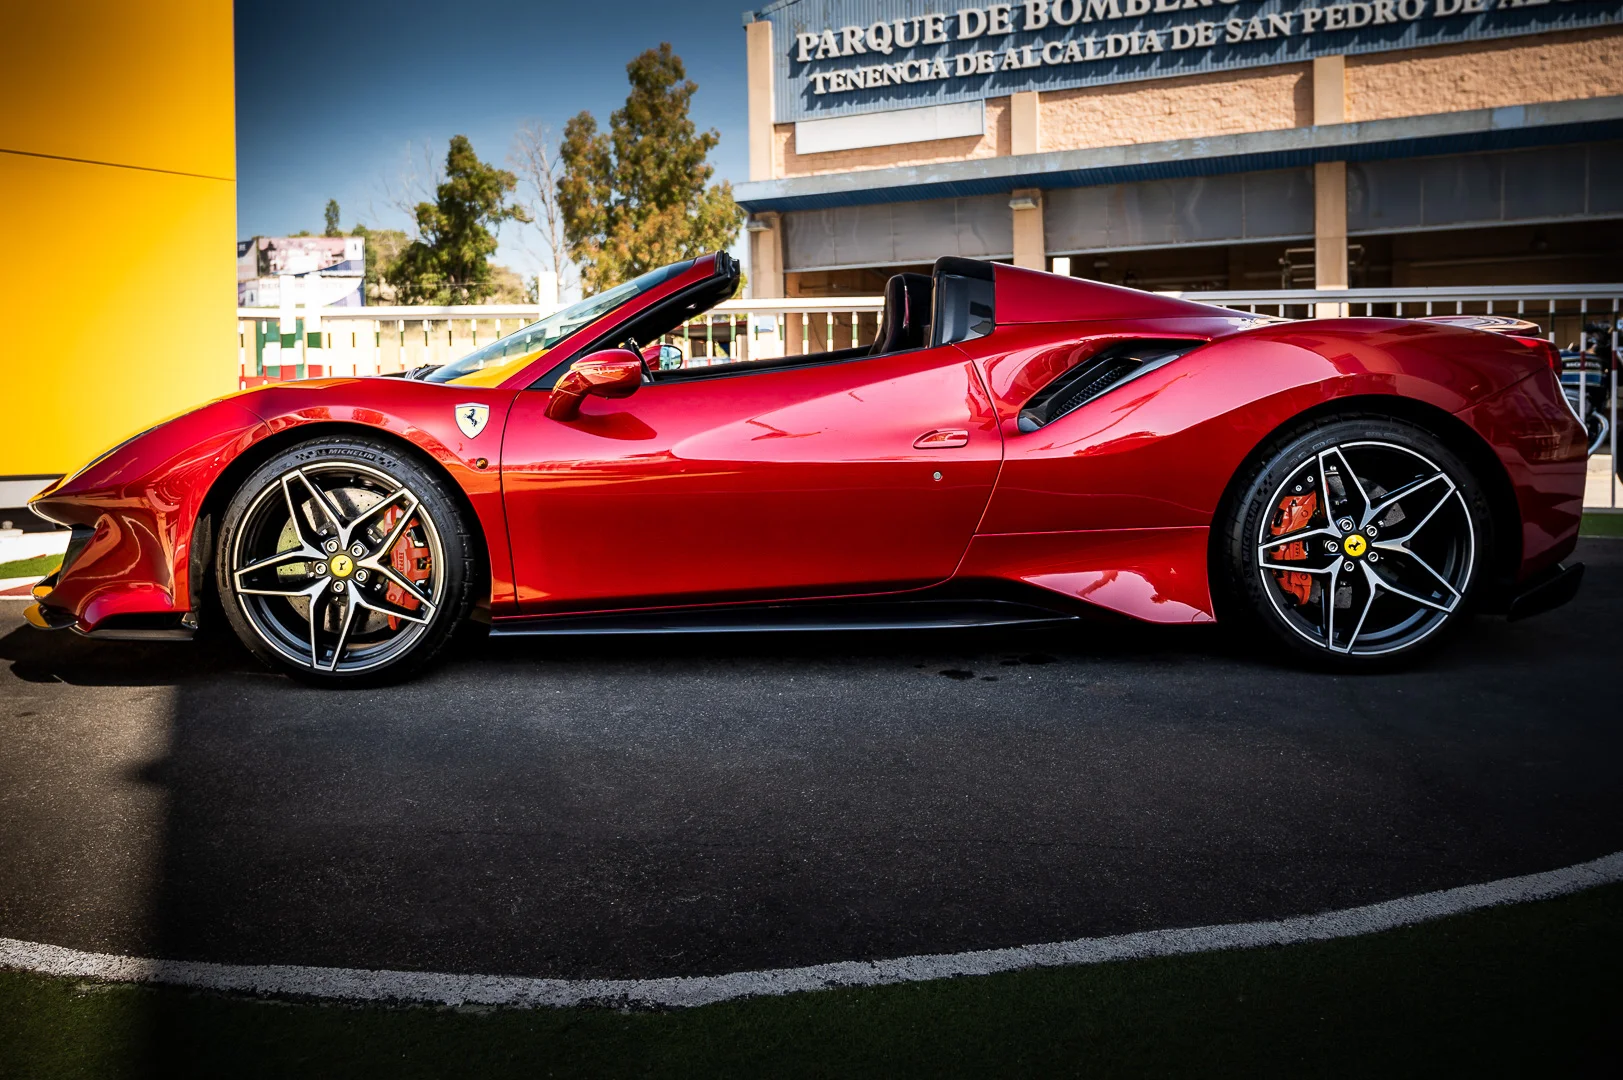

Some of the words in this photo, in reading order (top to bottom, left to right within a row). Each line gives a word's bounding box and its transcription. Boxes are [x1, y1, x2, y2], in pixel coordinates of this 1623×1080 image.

[796, 14, 948, 62] PARQUE
[956, 3, 1014, 40] DE
[808, 57, 950, 95] TENENCIA
[955, 50, 995, 77] DE
[1001, 29, 1163, 71] ALCALDIA
[1171, 22, 1216, 50] DE
[1225, 12, 1293, 43] SAN
[1302, 0, 1425, 34] PEDRO
[328, 448, 376, 461] MICHELIN
[1242, 500, 1259, 561] MICHELIN
